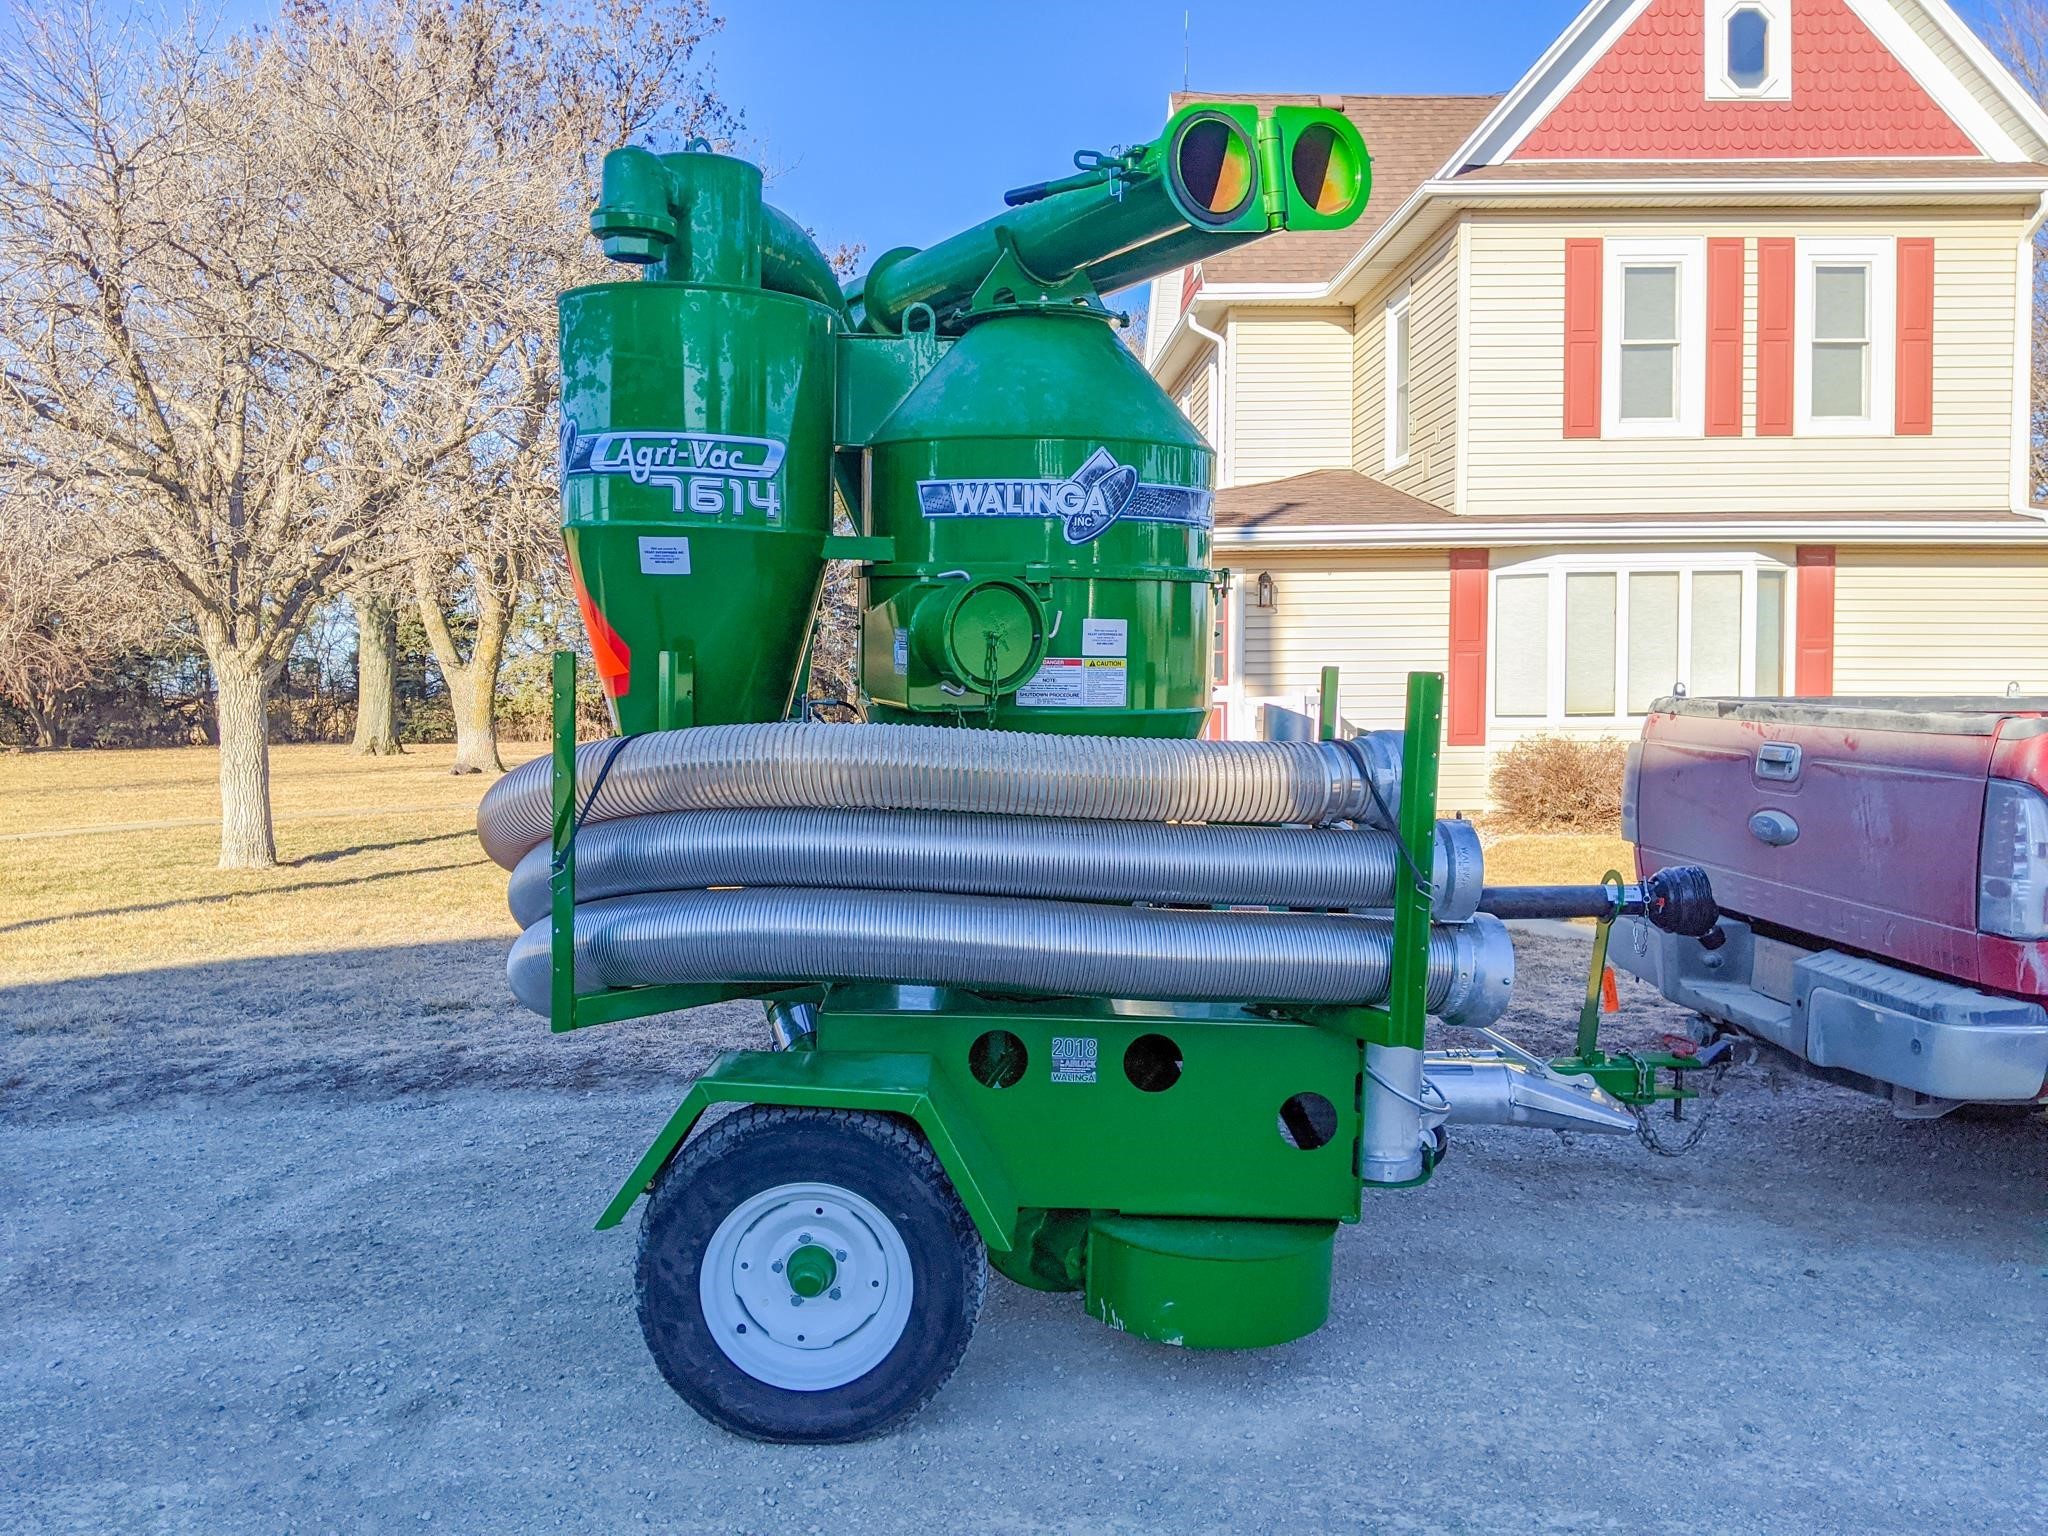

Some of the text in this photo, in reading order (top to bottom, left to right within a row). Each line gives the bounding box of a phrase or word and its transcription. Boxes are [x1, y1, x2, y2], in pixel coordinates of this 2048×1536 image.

[616, 437, 743, 484] Agri-Vac
[650, 475, 781, 519] 7614
[952, 481, 1109, 517] WALINGA
[1073, 516, 1096, 529] INC.
[1051, 1037, 1098, 1058] 2018
[1052, 1072, 1095, 1082] WALINGA
